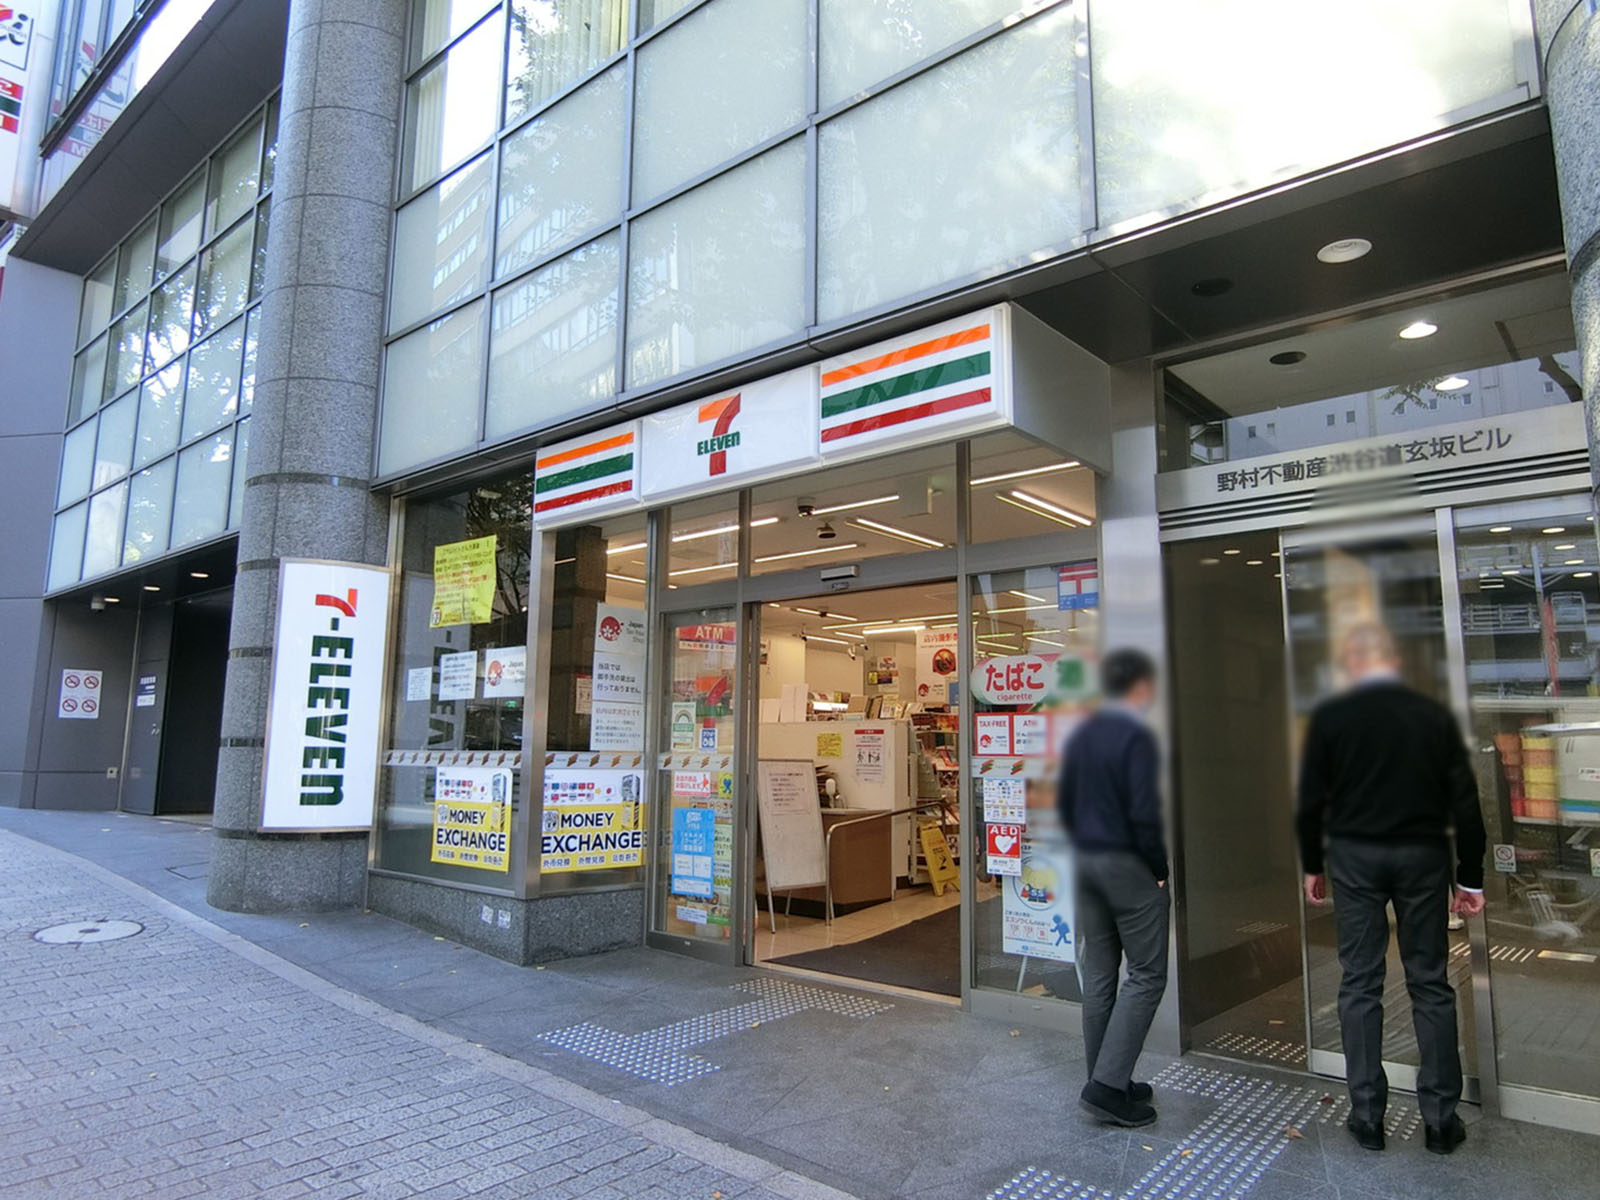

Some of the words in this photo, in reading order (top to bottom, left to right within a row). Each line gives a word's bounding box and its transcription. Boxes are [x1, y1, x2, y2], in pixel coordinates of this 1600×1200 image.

[695, 625, 724, 640] ATM
[985, 662, 1045, 691] たばこ
[996, 692, 1033, 702] cigarette
[449, 808, 487, 826] MONEY
[560, 812, 615, 829] MONEY
[990, 825, 1018, 836] AED
[436, 828, 506, 852] EXCHANGE
[541, 831, 641, 854] EXCHANGE
